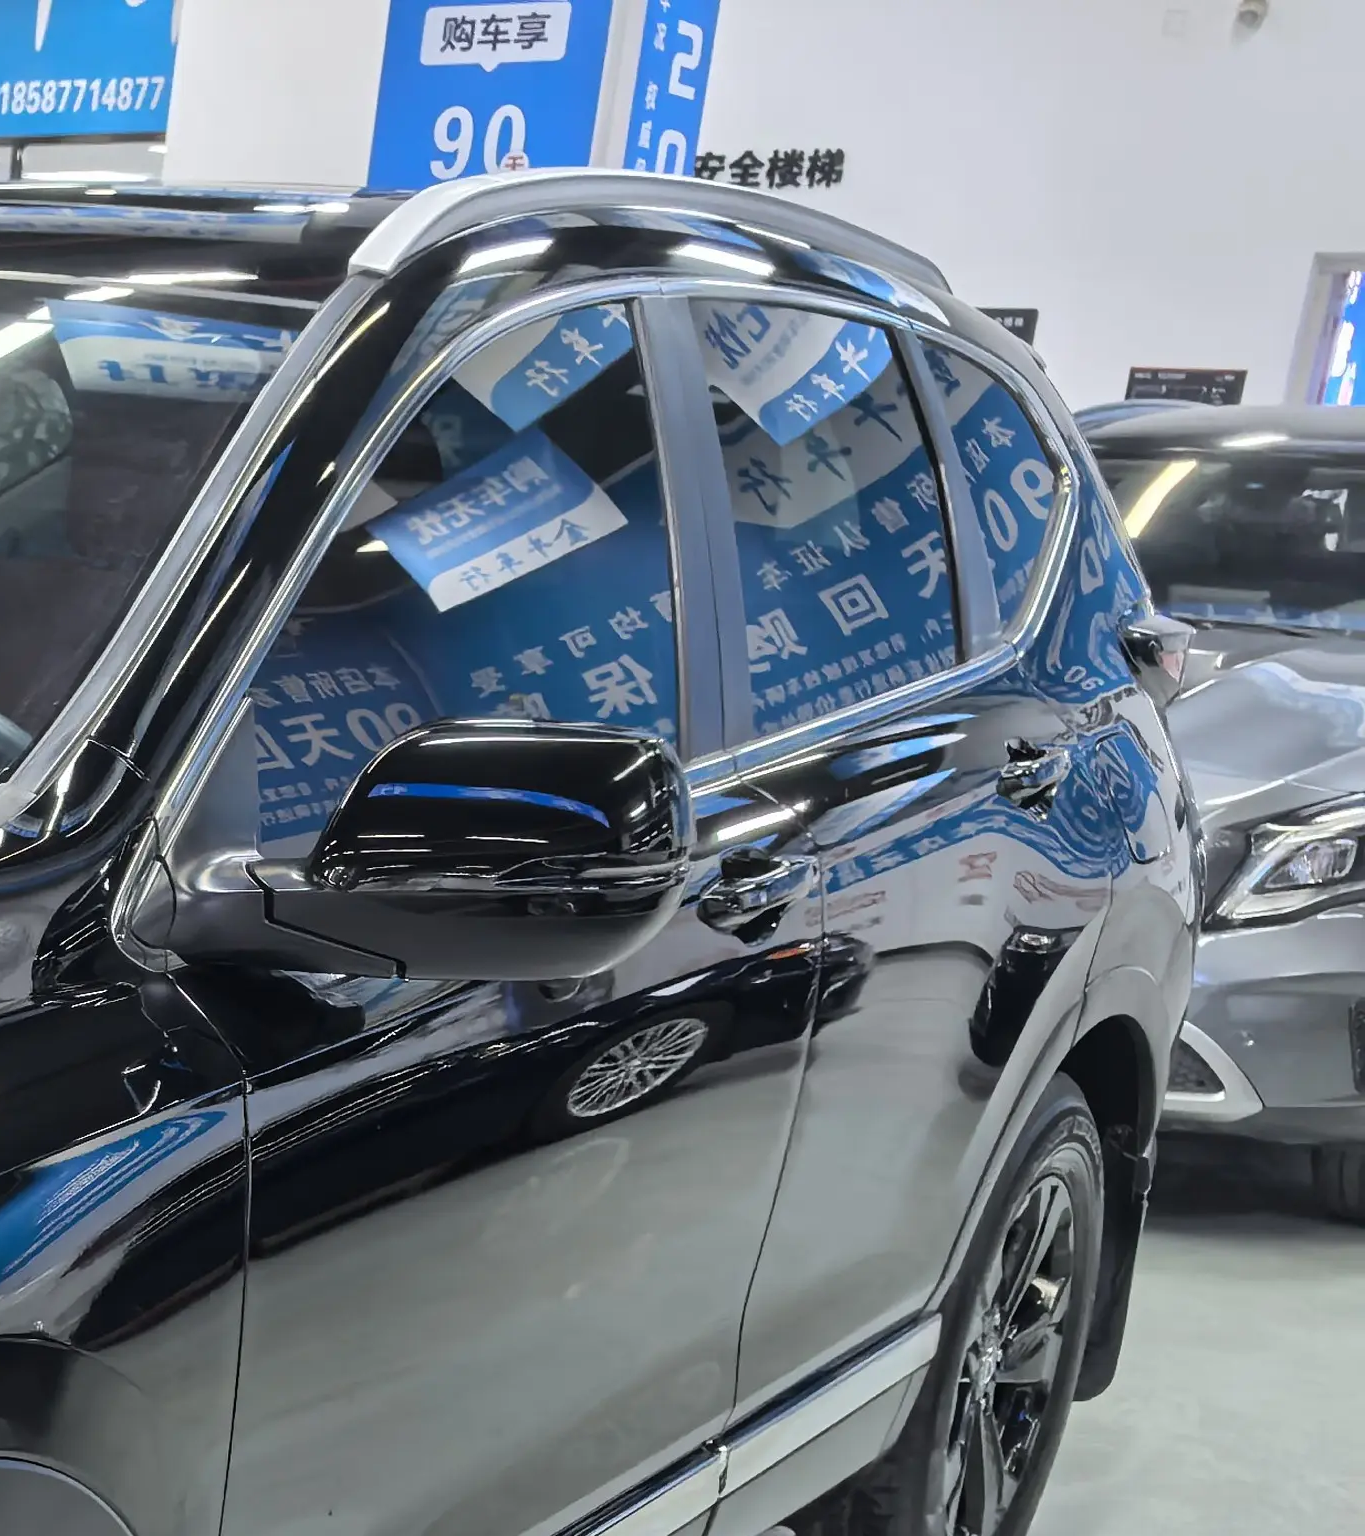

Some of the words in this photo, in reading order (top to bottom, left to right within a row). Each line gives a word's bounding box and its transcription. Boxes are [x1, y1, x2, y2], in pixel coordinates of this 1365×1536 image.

[439, 11, 552, 53] 购车享
[430, 104, 527, 180] 90
[694, 148, 845, 189] 安全楼梯
